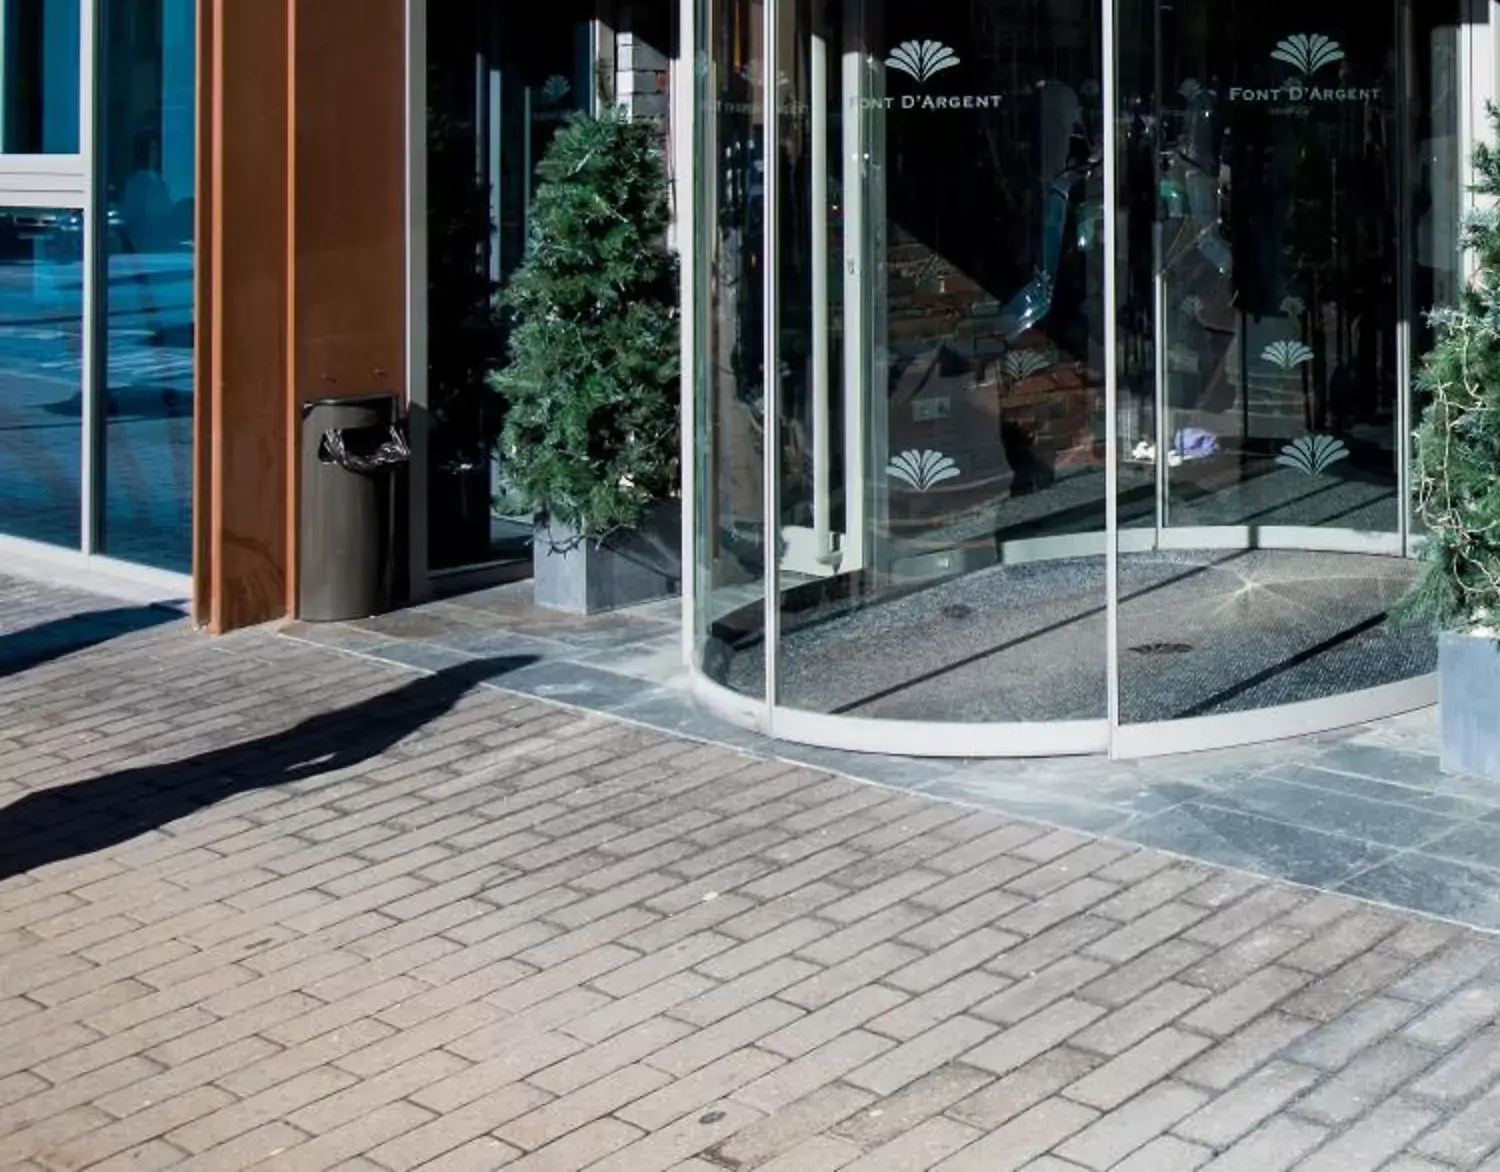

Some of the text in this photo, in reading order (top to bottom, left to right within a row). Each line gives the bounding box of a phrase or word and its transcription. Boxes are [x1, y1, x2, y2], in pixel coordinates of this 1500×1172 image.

[901, 93, 1003, 110] D'ARGENT
[1229, 86, 1380, 101] FONT D'ARGENT
